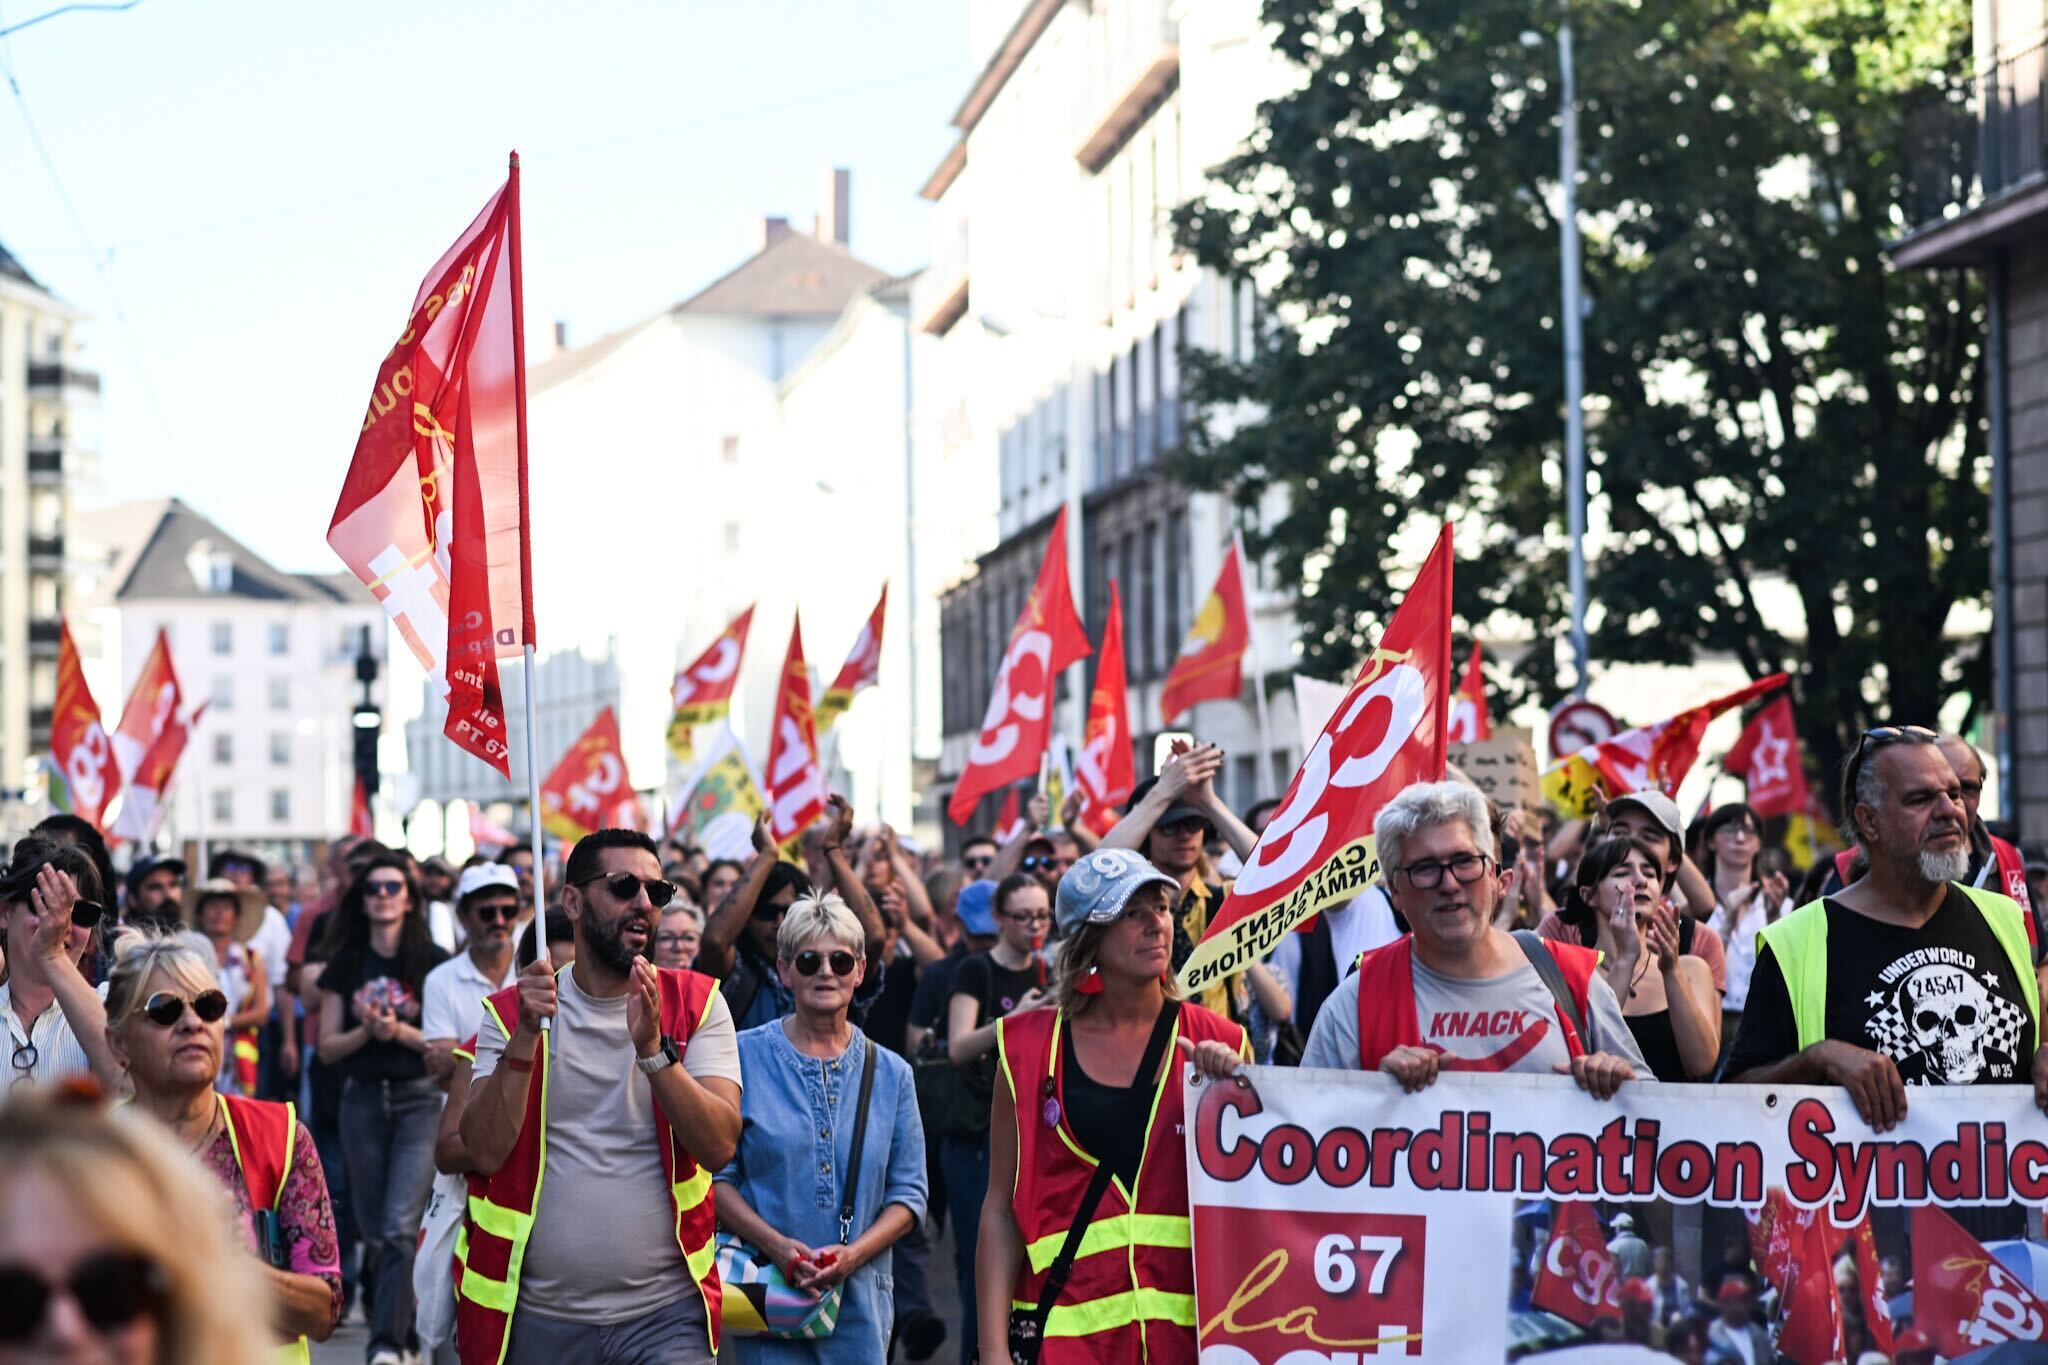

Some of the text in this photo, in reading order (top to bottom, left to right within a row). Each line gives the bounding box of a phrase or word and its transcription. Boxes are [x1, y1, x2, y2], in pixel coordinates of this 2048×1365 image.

[1878, 946, 1976, 984] UNDERWORLD
[1912, 973, 1966, 999] 24547
[1429, 1010, 1529, 1039] KNACK
[1195, 1078, 1764, 1202] Coordination
[1314, 1233, 1403, 1294] 67
